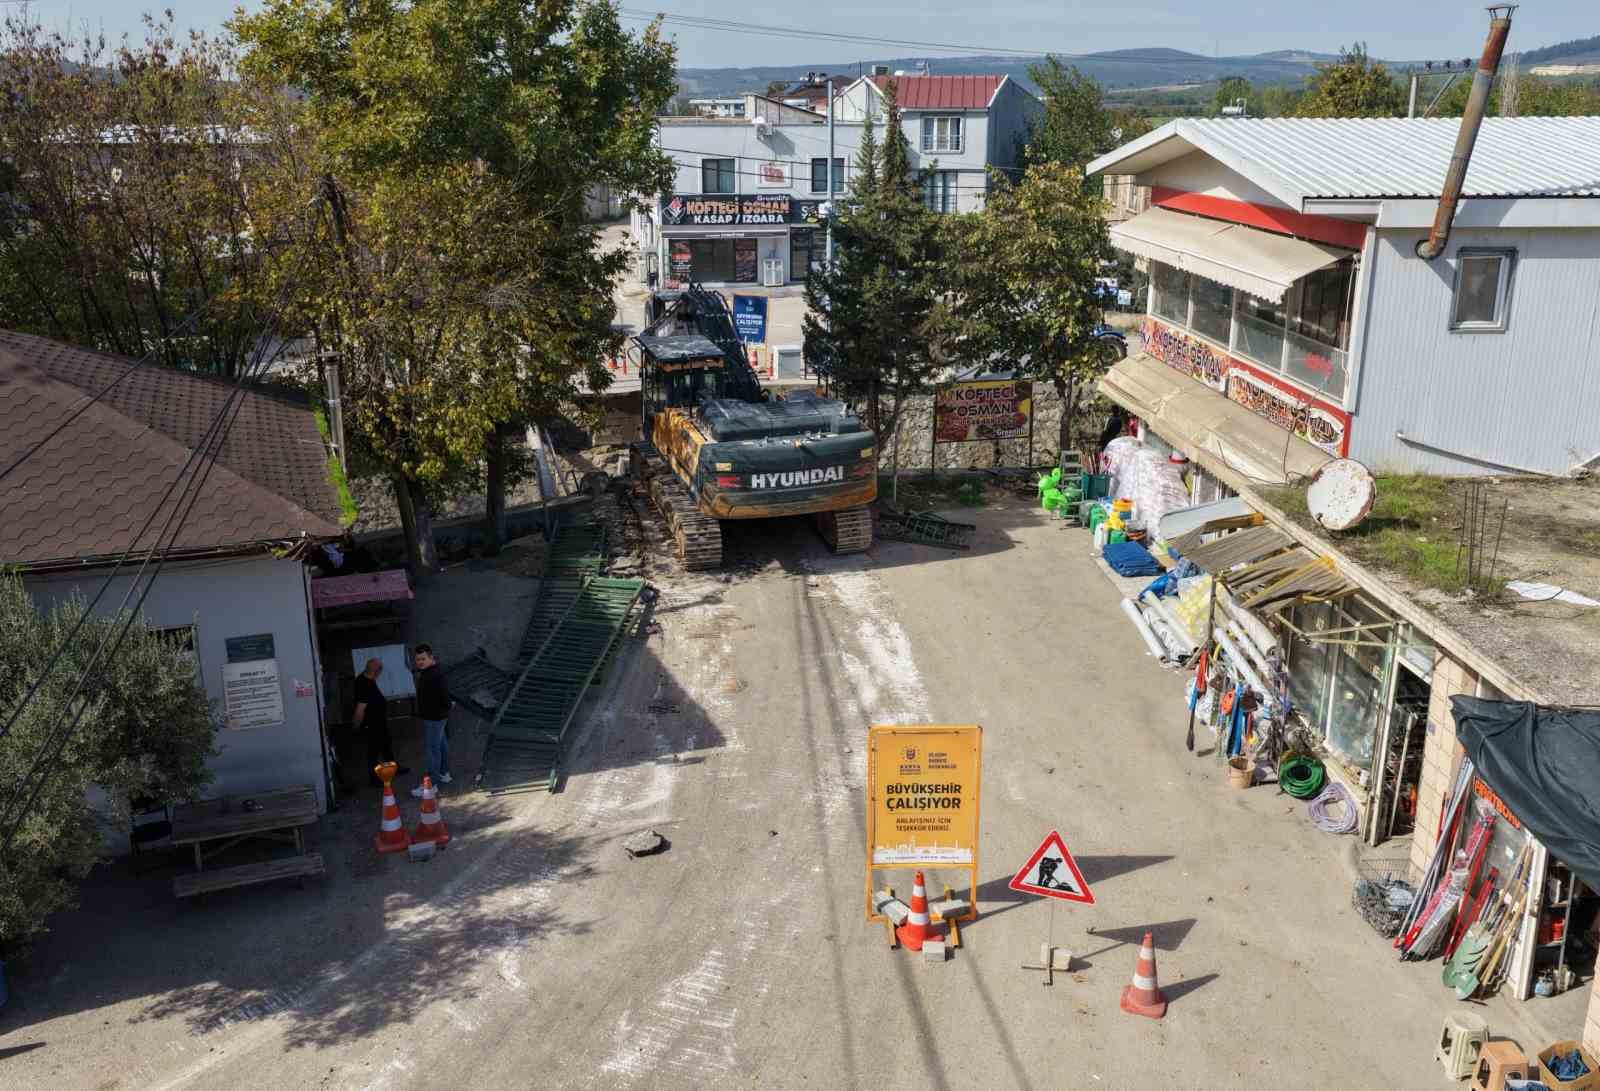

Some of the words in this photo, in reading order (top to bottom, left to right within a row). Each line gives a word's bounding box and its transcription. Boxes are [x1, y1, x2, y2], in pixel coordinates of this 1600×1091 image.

[693, 214, 733, 225] KASAP
[957, 402, 1011, 417] OSMAN
[751, 465, 844, 489] HYUNDAI
[886, 782, 962, 796] BÜYÜKŞEHİR
[886, 798, 961, 811] ÇALIŞIYOR
